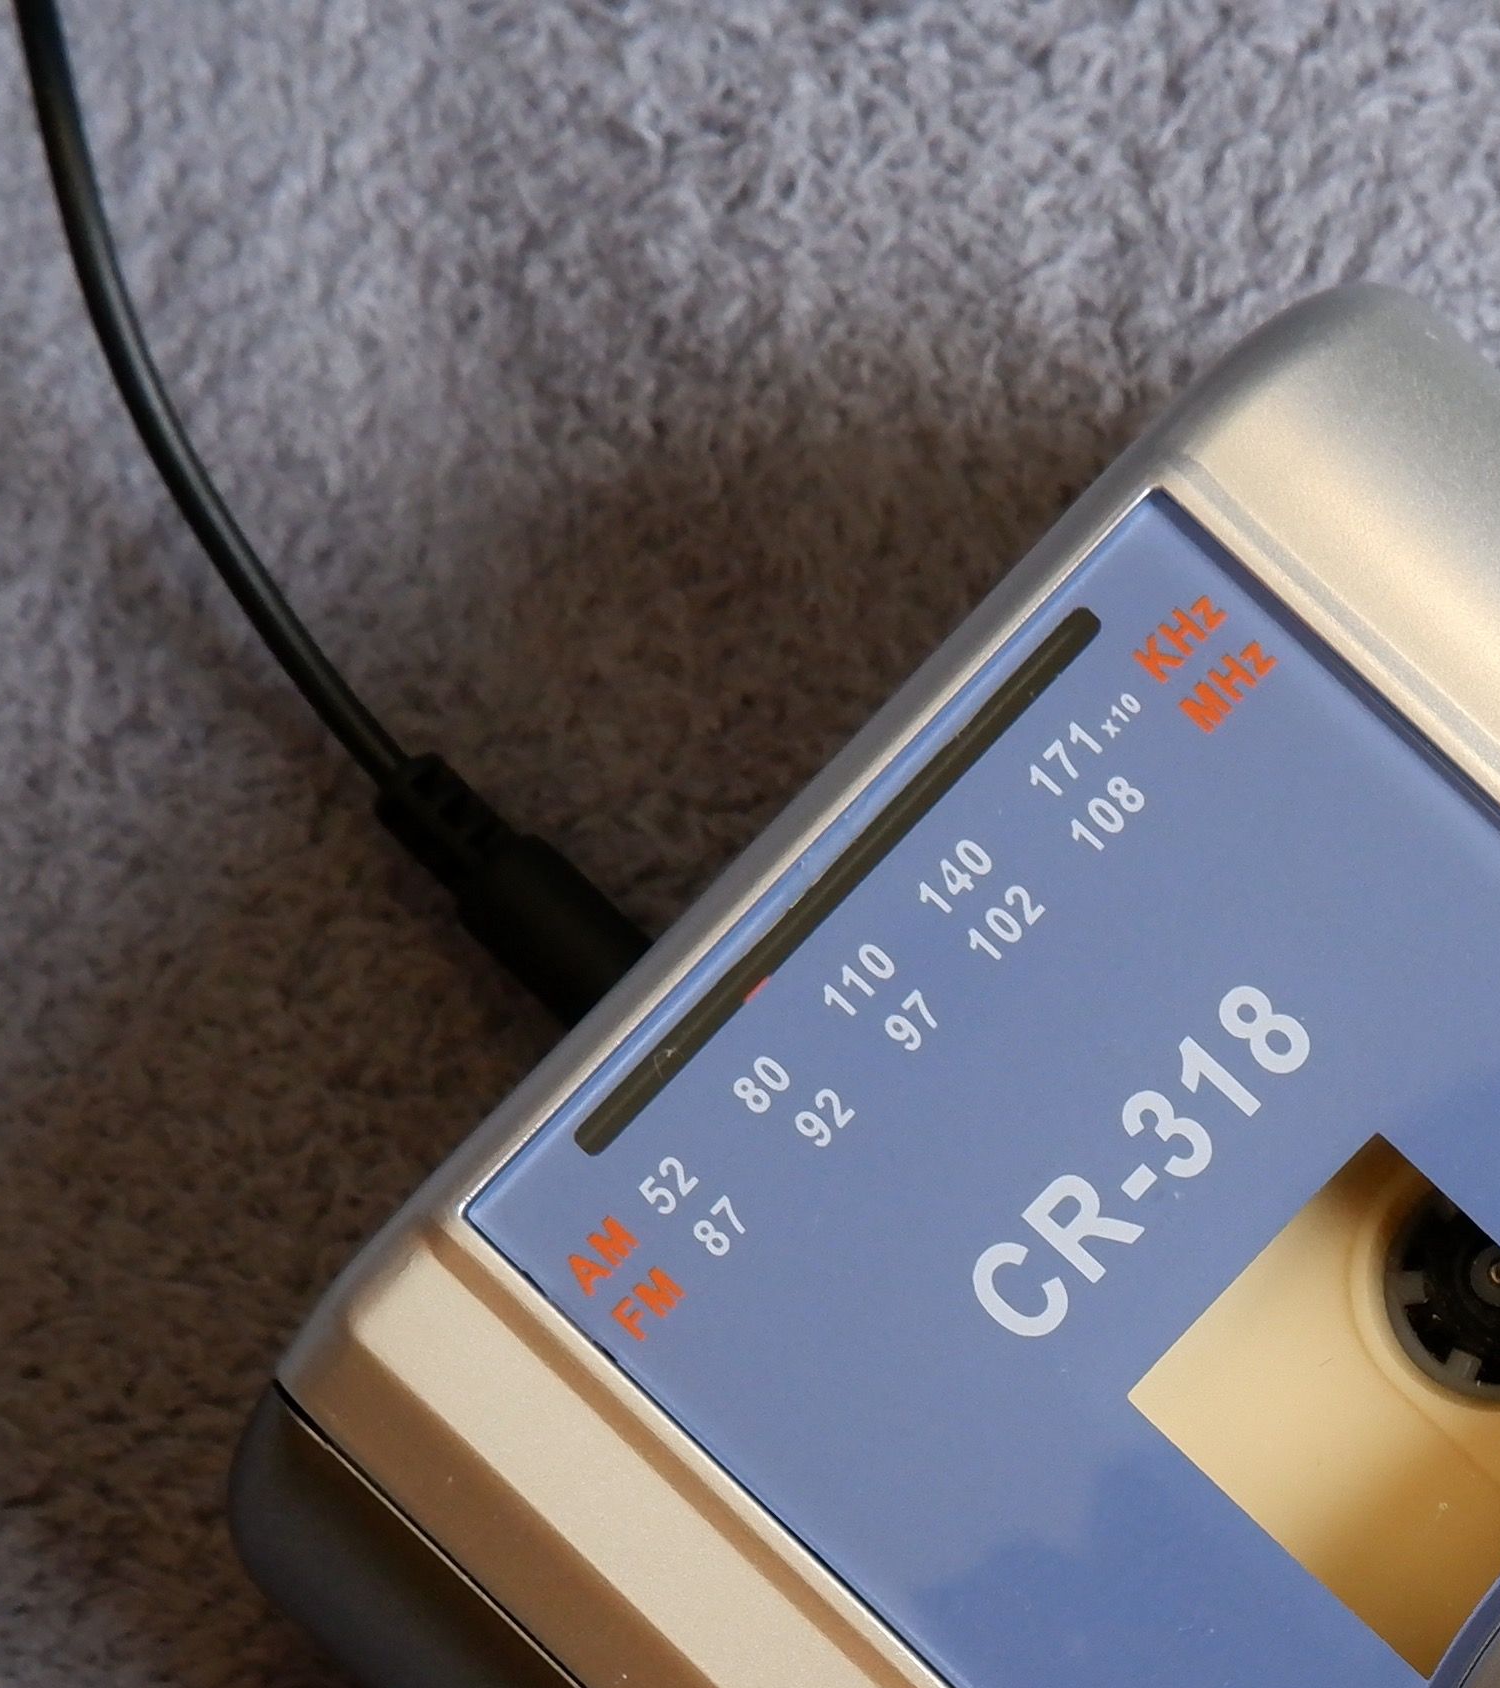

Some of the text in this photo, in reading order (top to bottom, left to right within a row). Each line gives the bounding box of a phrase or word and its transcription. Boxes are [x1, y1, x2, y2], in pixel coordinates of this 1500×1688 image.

[567, 1216, 640, 1297] AM
[638, 1156, 700, 1215] 52
[733, 1055, 791, 1114] 80
[823, 943, 896, 1017] 110
[919, 839, 993, 914] 140
[1029, 721, 1104, 796] 171
[1132, 595, 1228, 684] KHz
[611, 640, 1277, 1341] FM 87 92 97 102 108 MHz
[971, 985, 1312, 1338] CR-318
